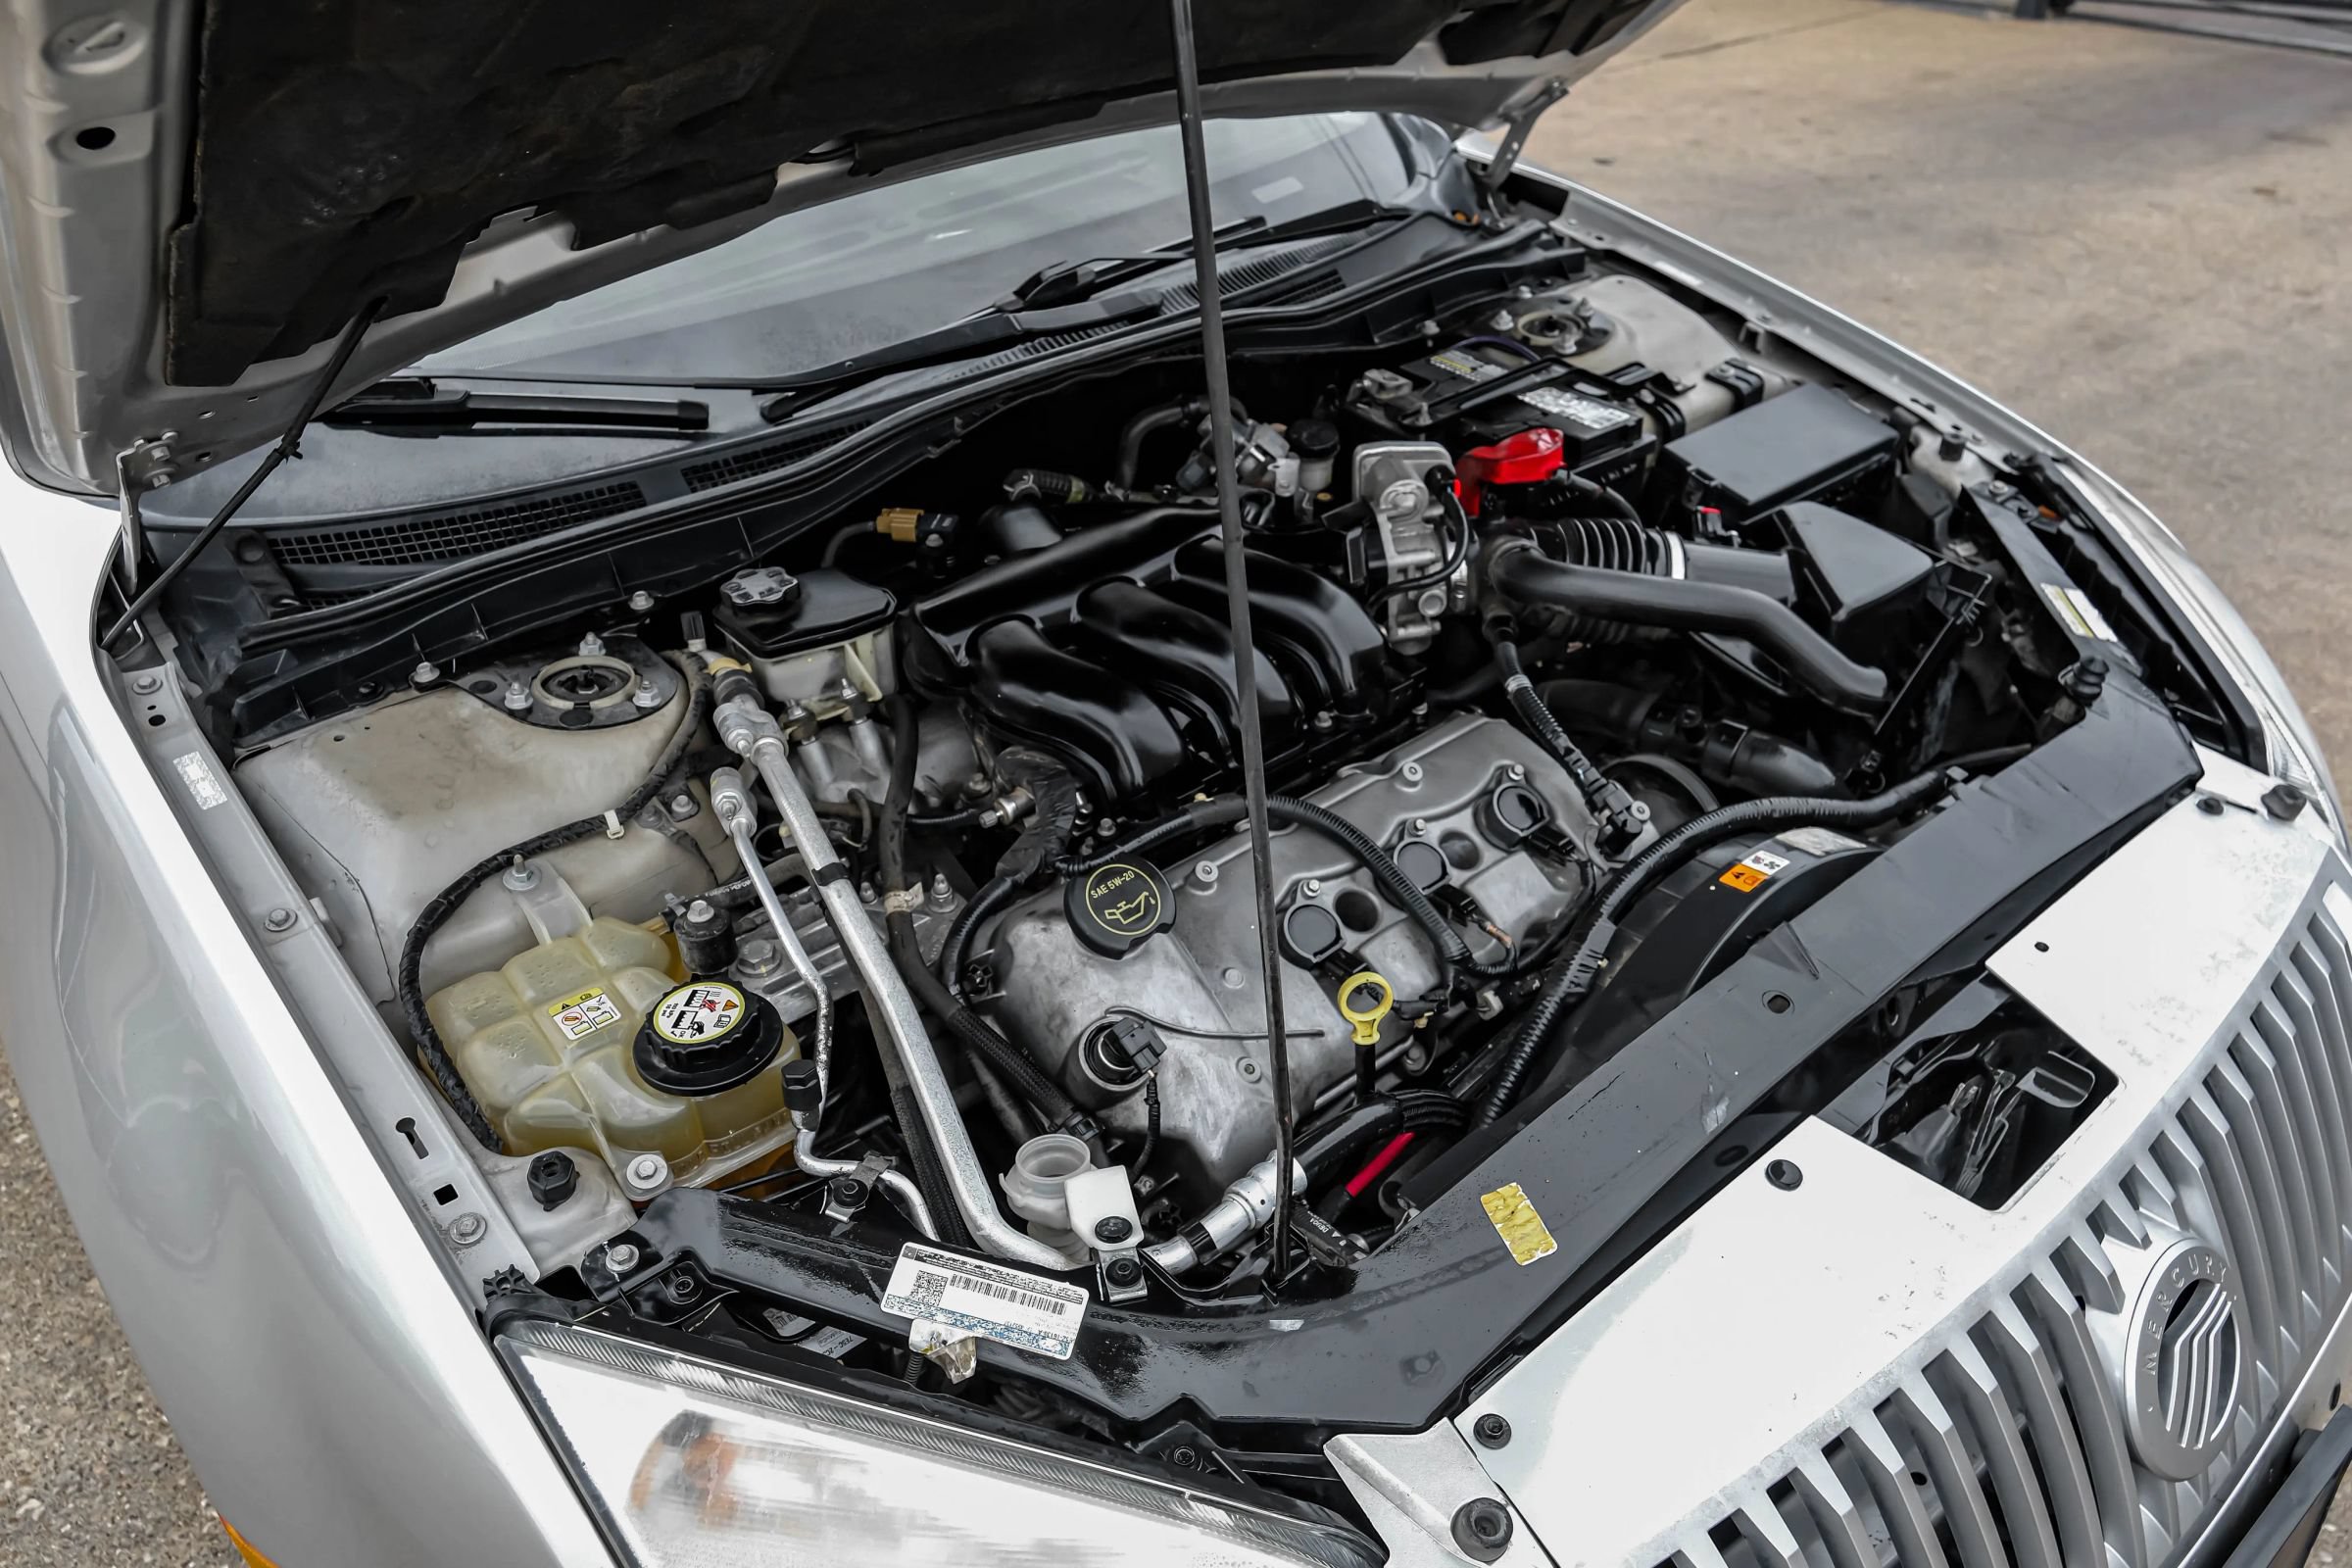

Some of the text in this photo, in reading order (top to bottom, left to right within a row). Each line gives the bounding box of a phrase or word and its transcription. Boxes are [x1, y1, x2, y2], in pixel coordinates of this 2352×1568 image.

[1091, 870, 1135, 899] SAE 5W-20
[2142, 1252, 2228, 1376] MERCURY
